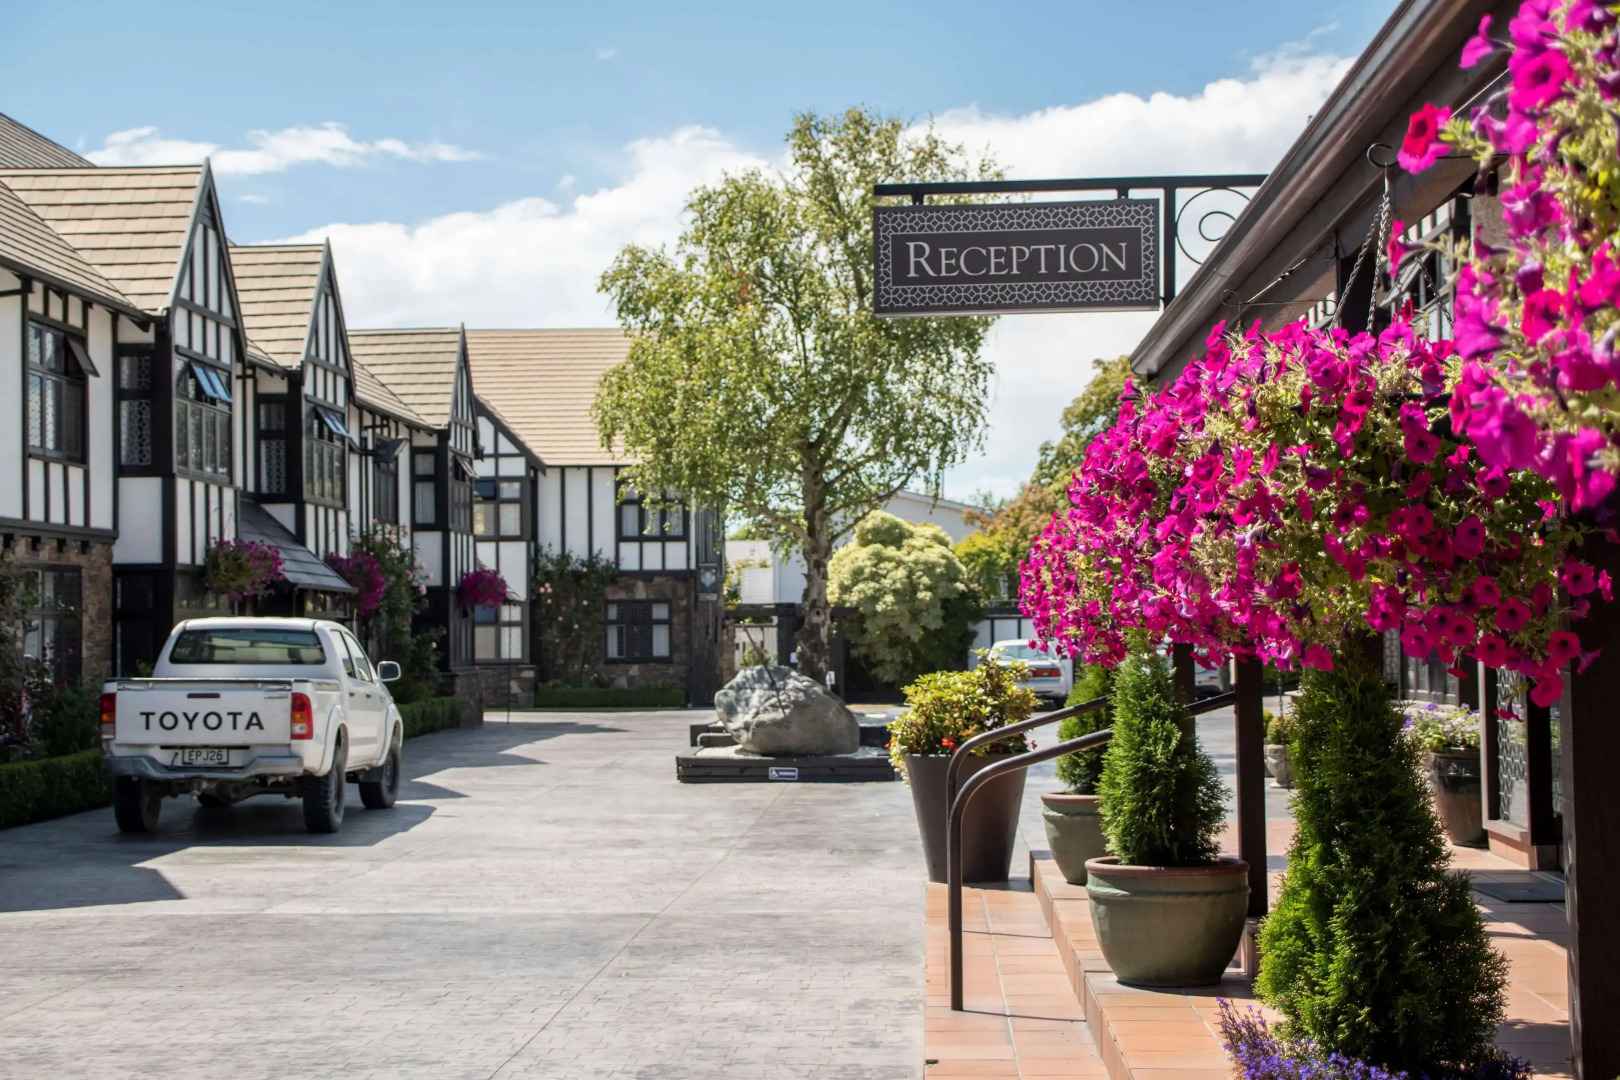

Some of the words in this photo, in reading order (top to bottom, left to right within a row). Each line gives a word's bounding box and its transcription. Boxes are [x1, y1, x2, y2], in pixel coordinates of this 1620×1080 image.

[905, 241, 1127, 278] RECEPTION
[139, 711, 265, 731] TOYOTA
[188, 750, 223, 761] EPJ26
